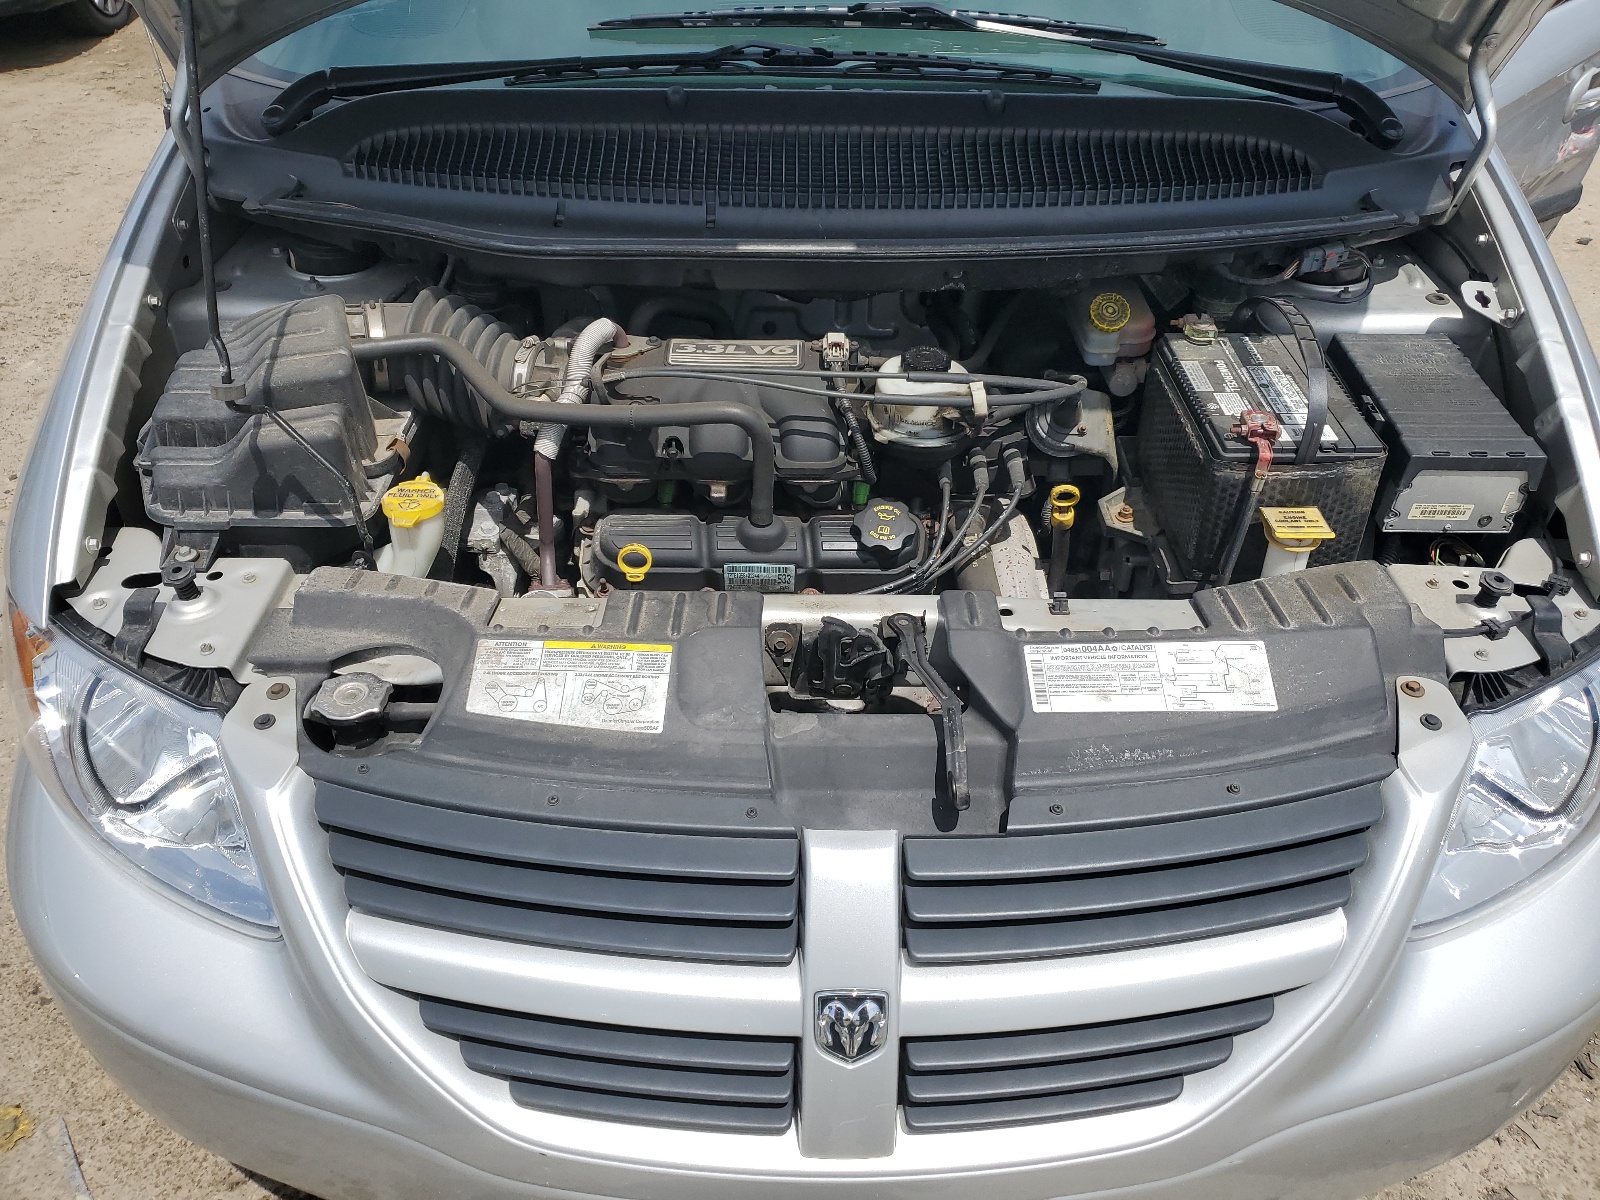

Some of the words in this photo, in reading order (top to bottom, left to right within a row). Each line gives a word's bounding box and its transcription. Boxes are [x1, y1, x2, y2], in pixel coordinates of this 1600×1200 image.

[675, 344, 747, 354] 3.3L
[751, 345, 794, 355] V6
[1213, 360, 1241, 392] POWERCELL
[778, 573, 792, 584] 533
